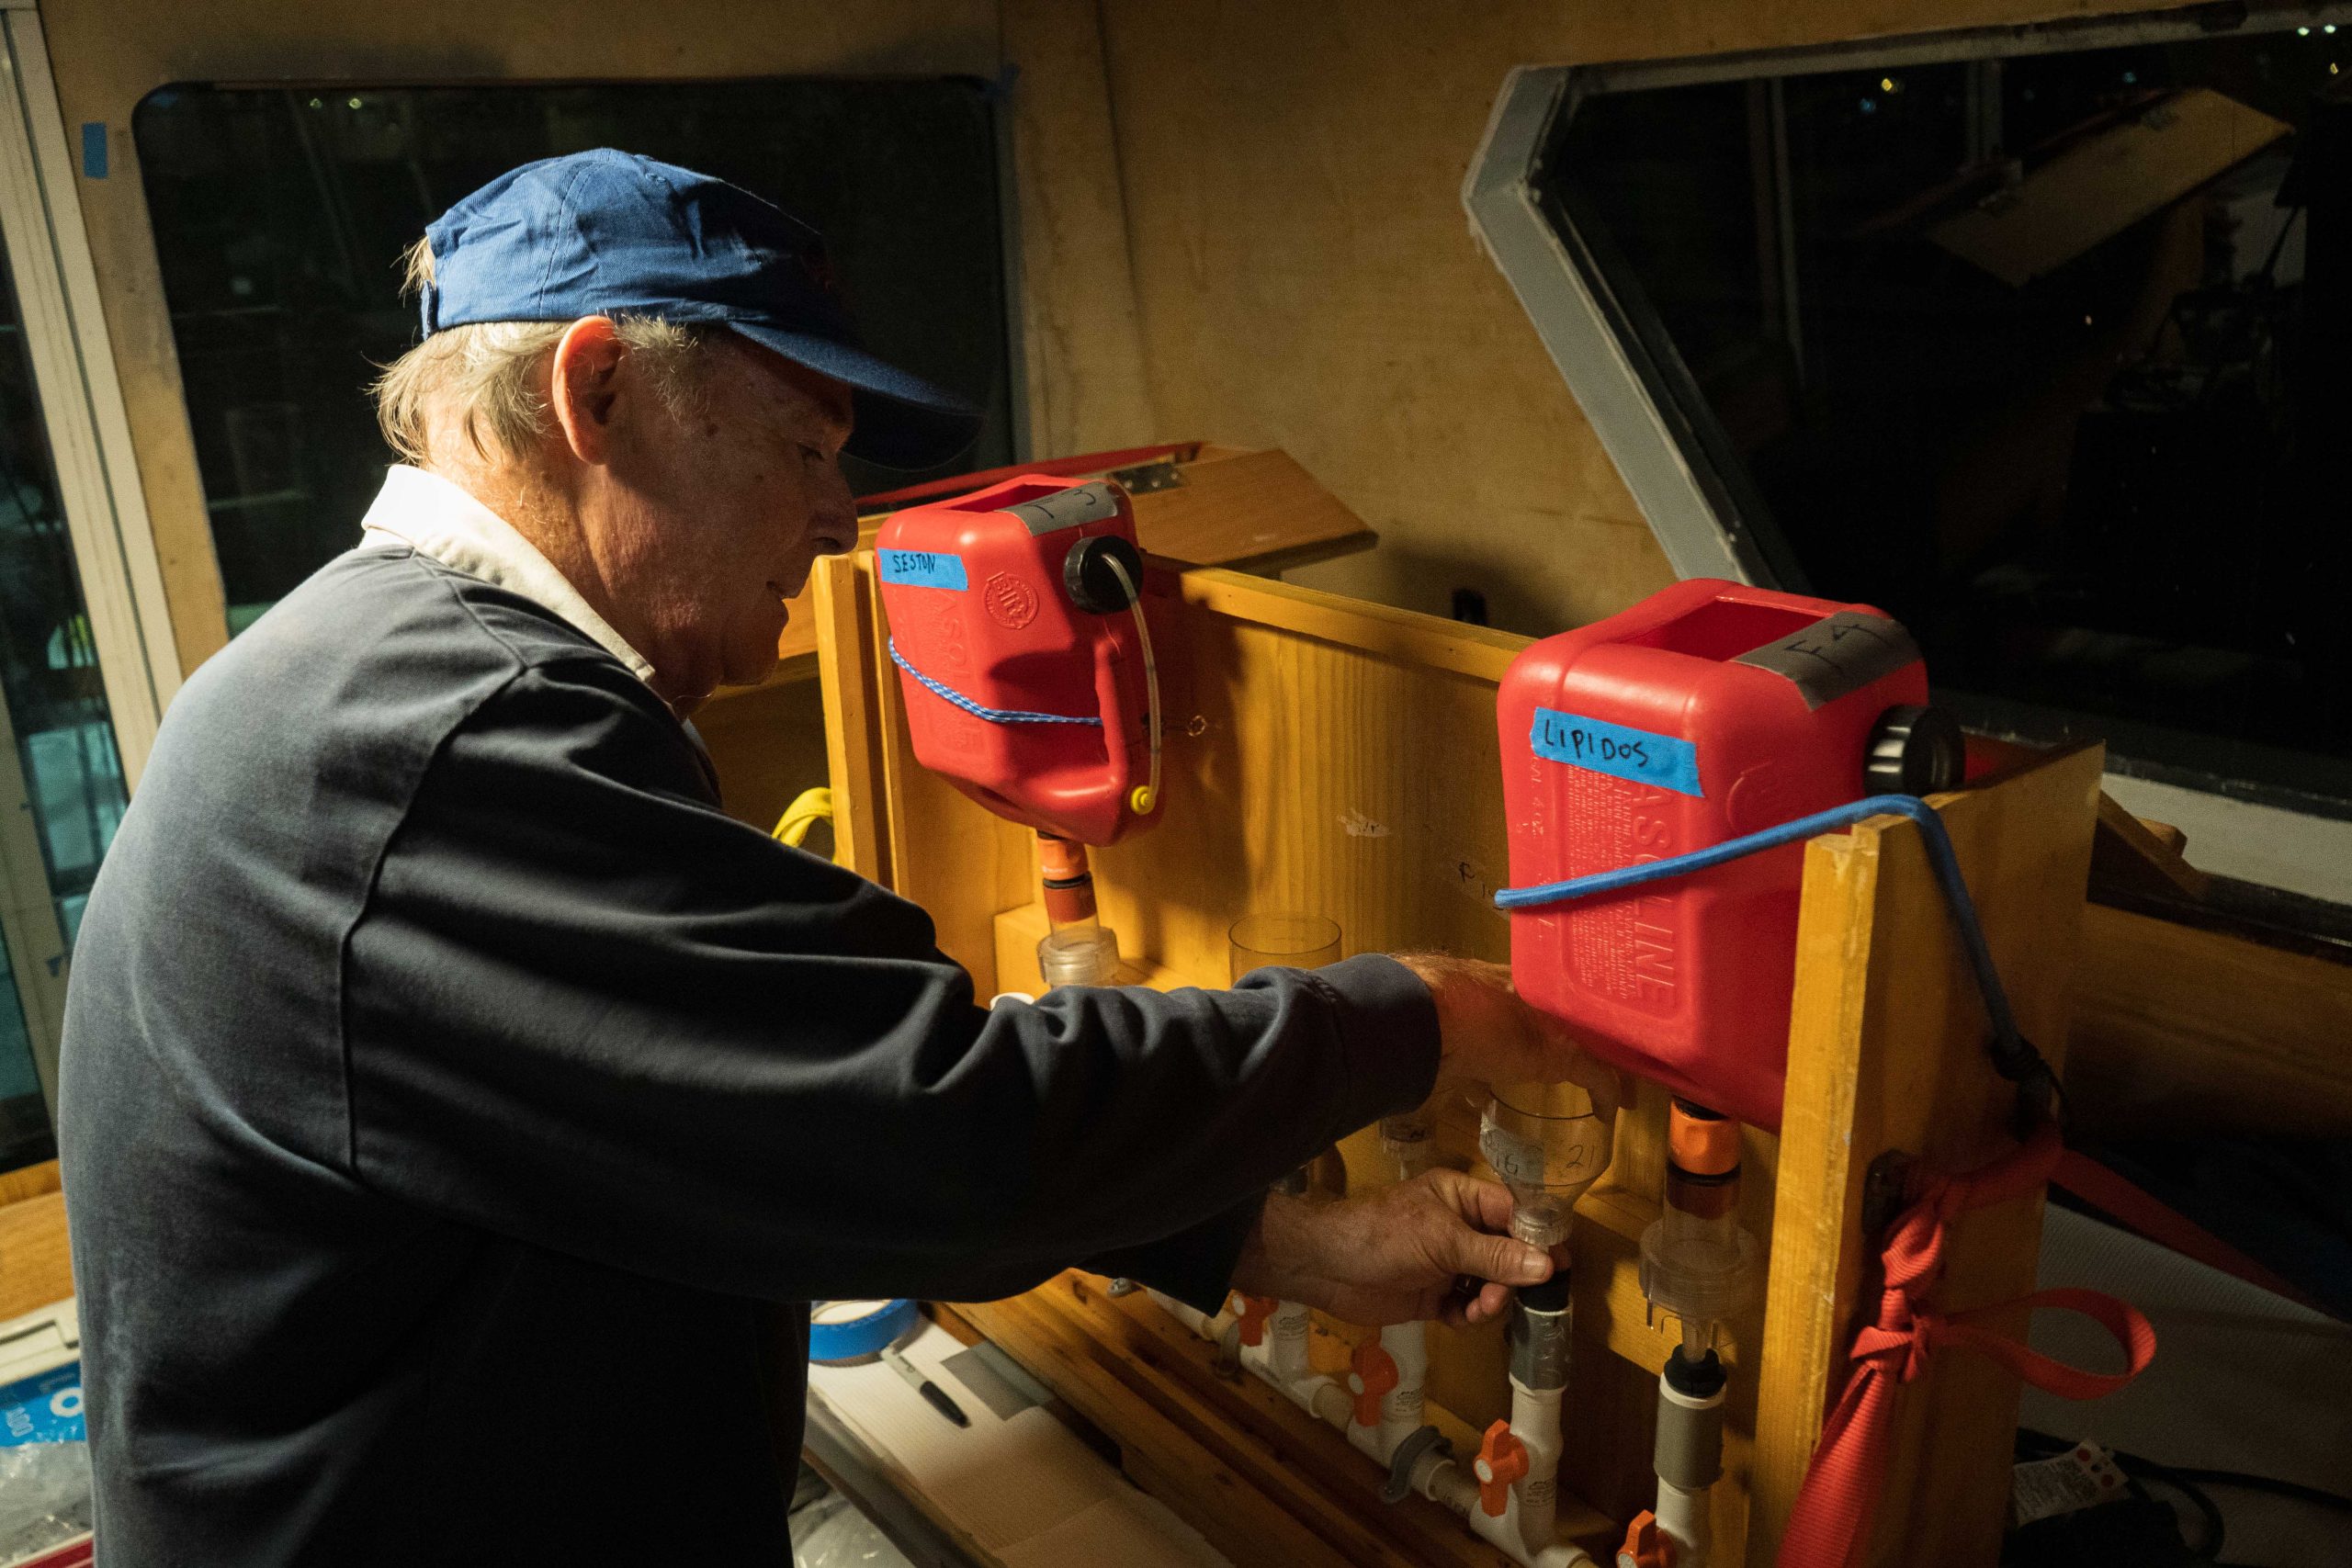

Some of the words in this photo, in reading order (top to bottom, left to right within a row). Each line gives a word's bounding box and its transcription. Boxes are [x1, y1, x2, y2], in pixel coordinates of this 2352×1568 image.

[892, 553, 935, 574] SESTON
[1544, 719, 1648, 768] LIPIDOS
[1632, 784, 1677, 1004] ASLINE
[1566, 1144, 1595, 1169] 21
